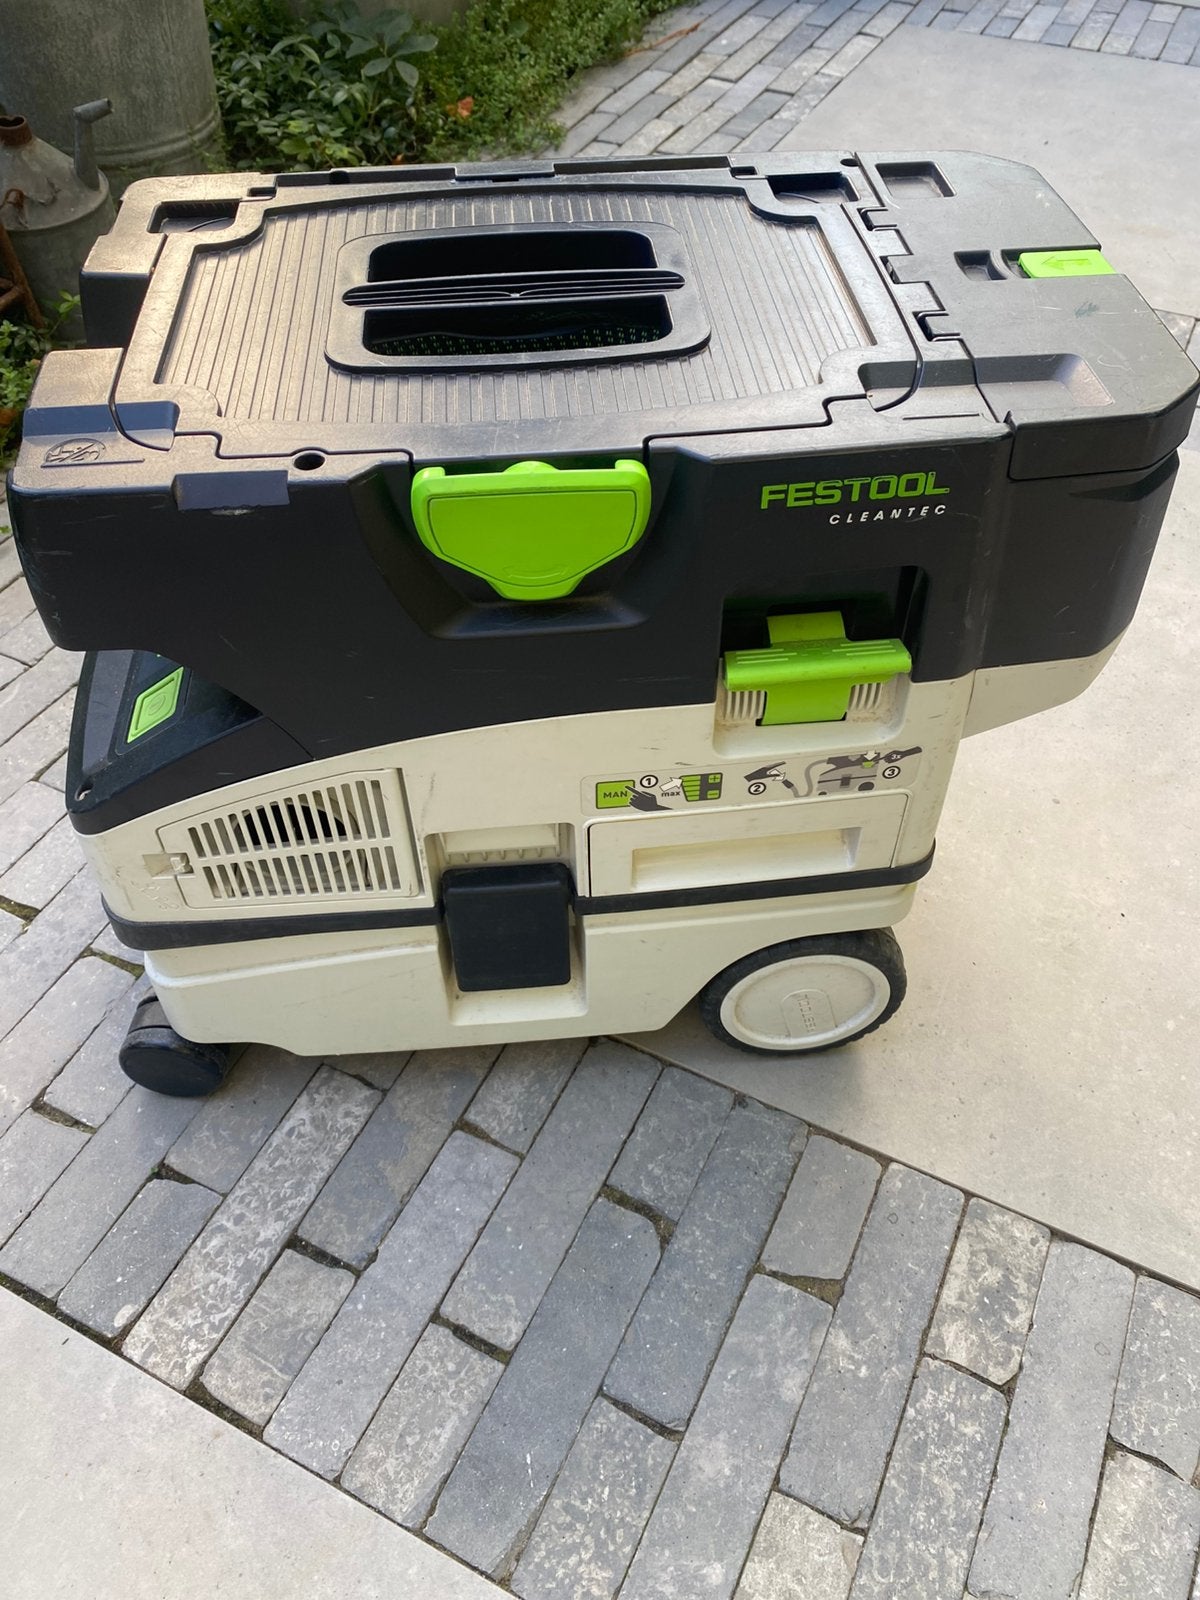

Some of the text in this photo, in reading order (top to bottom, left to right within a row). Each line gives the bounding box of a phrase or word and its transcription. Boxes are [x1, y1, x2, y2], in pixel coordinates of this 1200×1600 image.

[760, 471, 950, 510] FESTOOL
[829, 504, 946, 525] CLEANTEC
[602, 790, 628, 799] MAN
[661, 790, 681, 798] max
